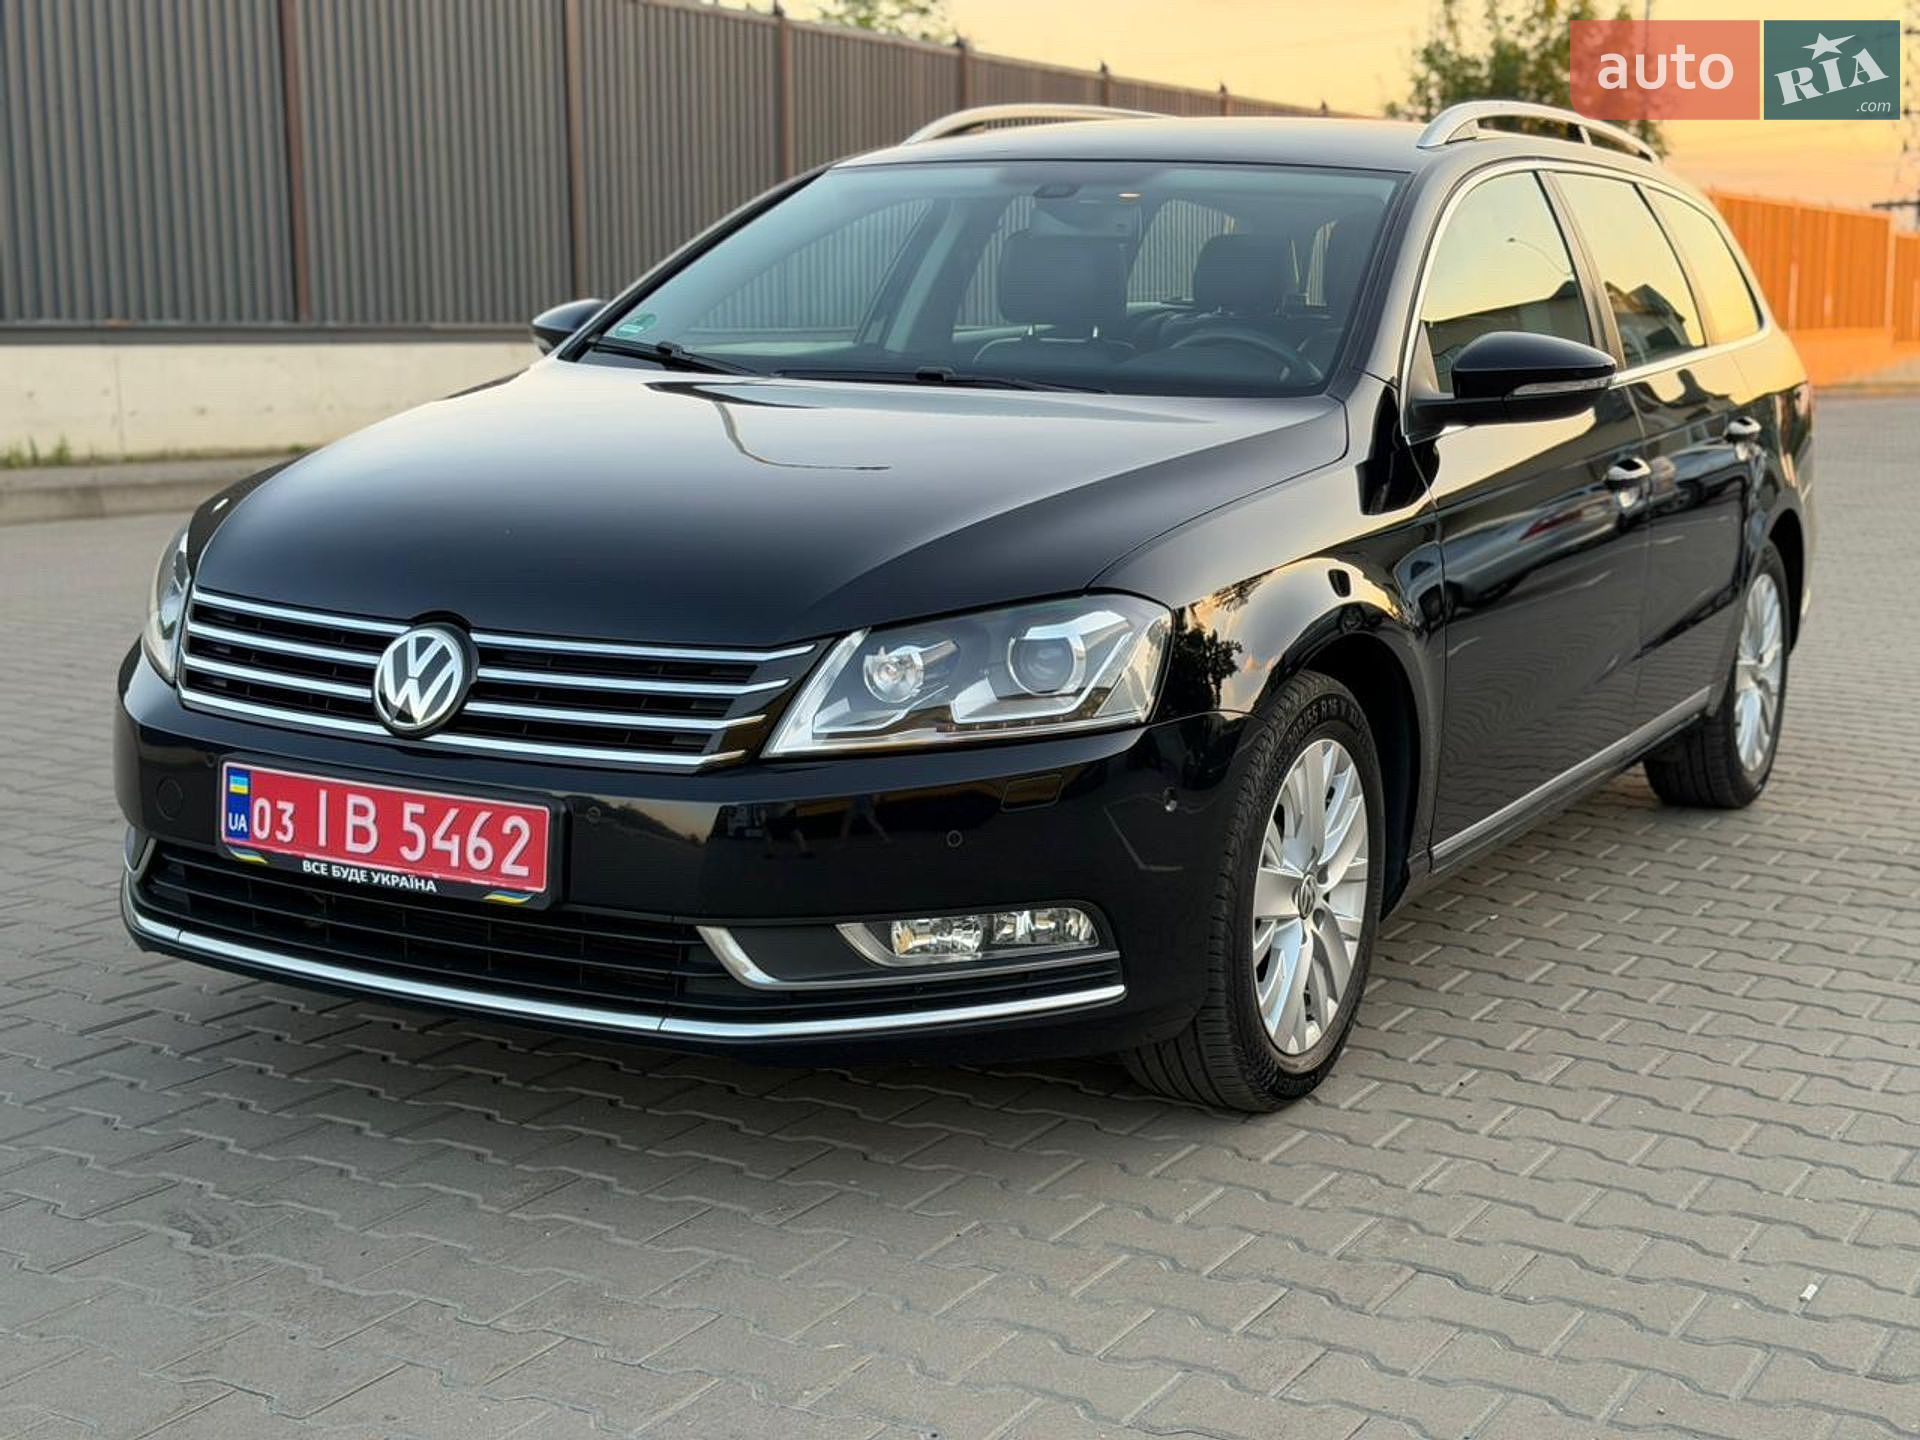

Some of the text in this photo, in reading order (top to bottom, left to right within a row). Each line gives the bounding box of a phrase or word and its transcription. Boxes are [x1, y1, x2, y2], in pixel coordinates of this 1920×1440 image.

[228, 812, 248, 833] UA
[252, 797, 295, 843] 03
[399, 803, 531, 876] 5462
[302, 860, 437, 893] ВСЕ БУДЕ УКРАЇНА
